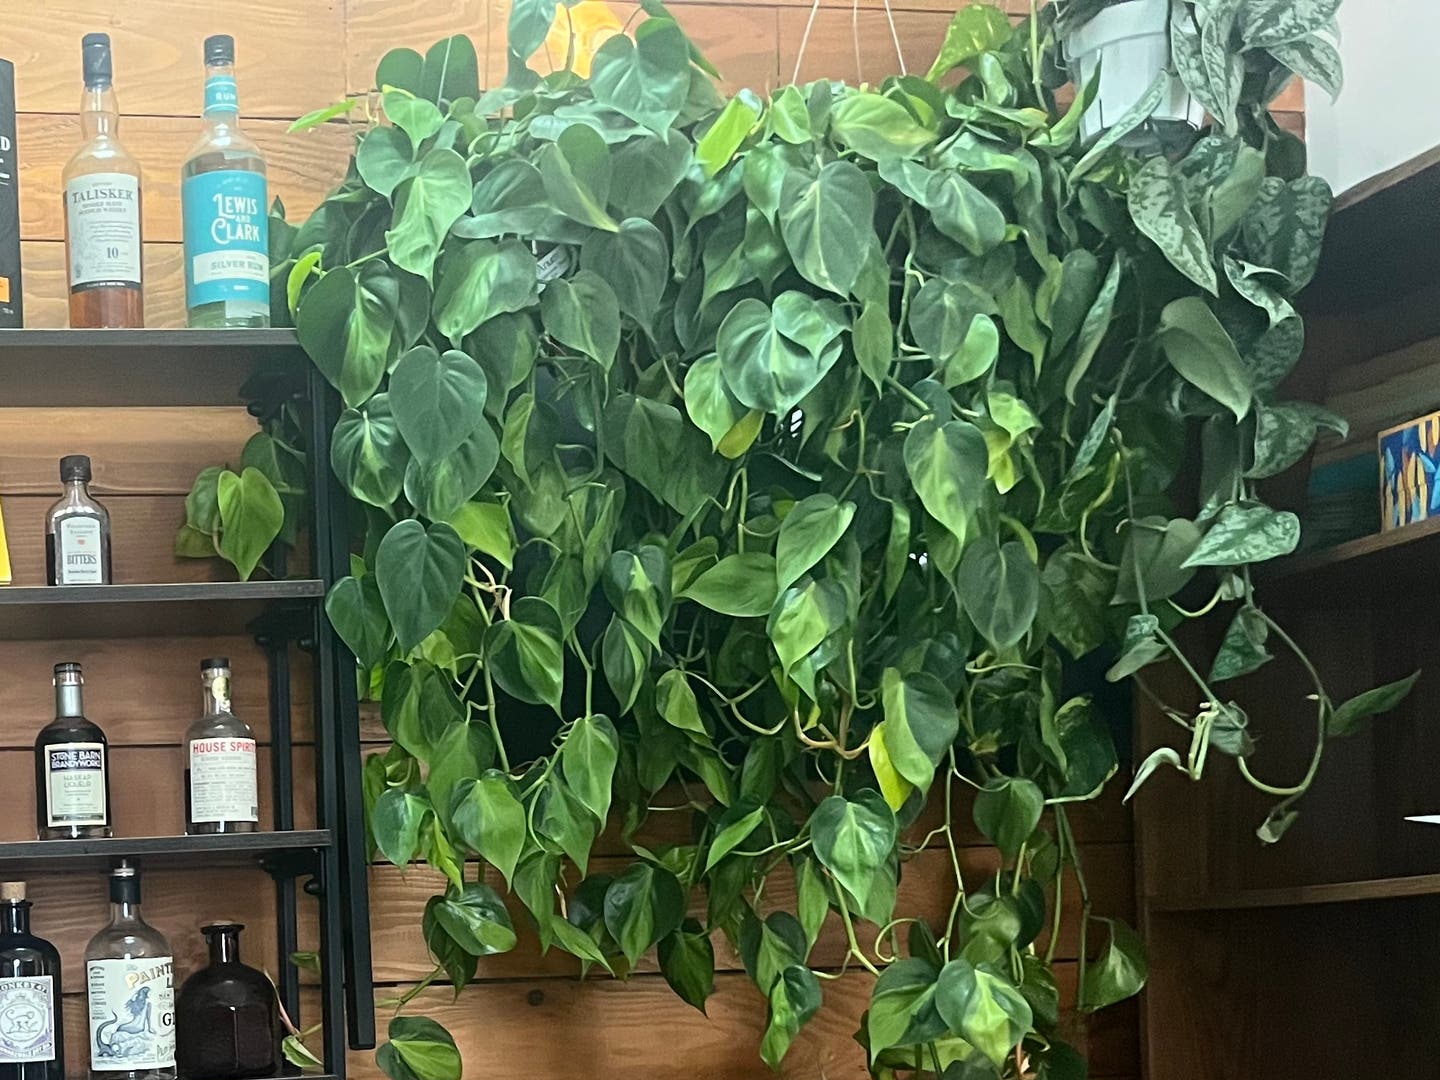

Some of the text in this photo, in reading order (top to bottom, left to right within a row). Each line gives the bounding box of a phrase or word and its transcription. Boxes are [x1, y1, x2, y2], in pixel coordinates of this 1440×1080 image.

[71, 188, 134, 204] TALISKER
[212, 193, 258, 219] LEWIS
[211, 217, 260, 245] CLARK
[106, 247, 119, 258] 10
[210, 260, 245, 270] SILVER
[192, 741, 226, 753] HOUSE
[51, 750, 101, 761] STONE BARN
[125, 963, 173, 990] PAINT
